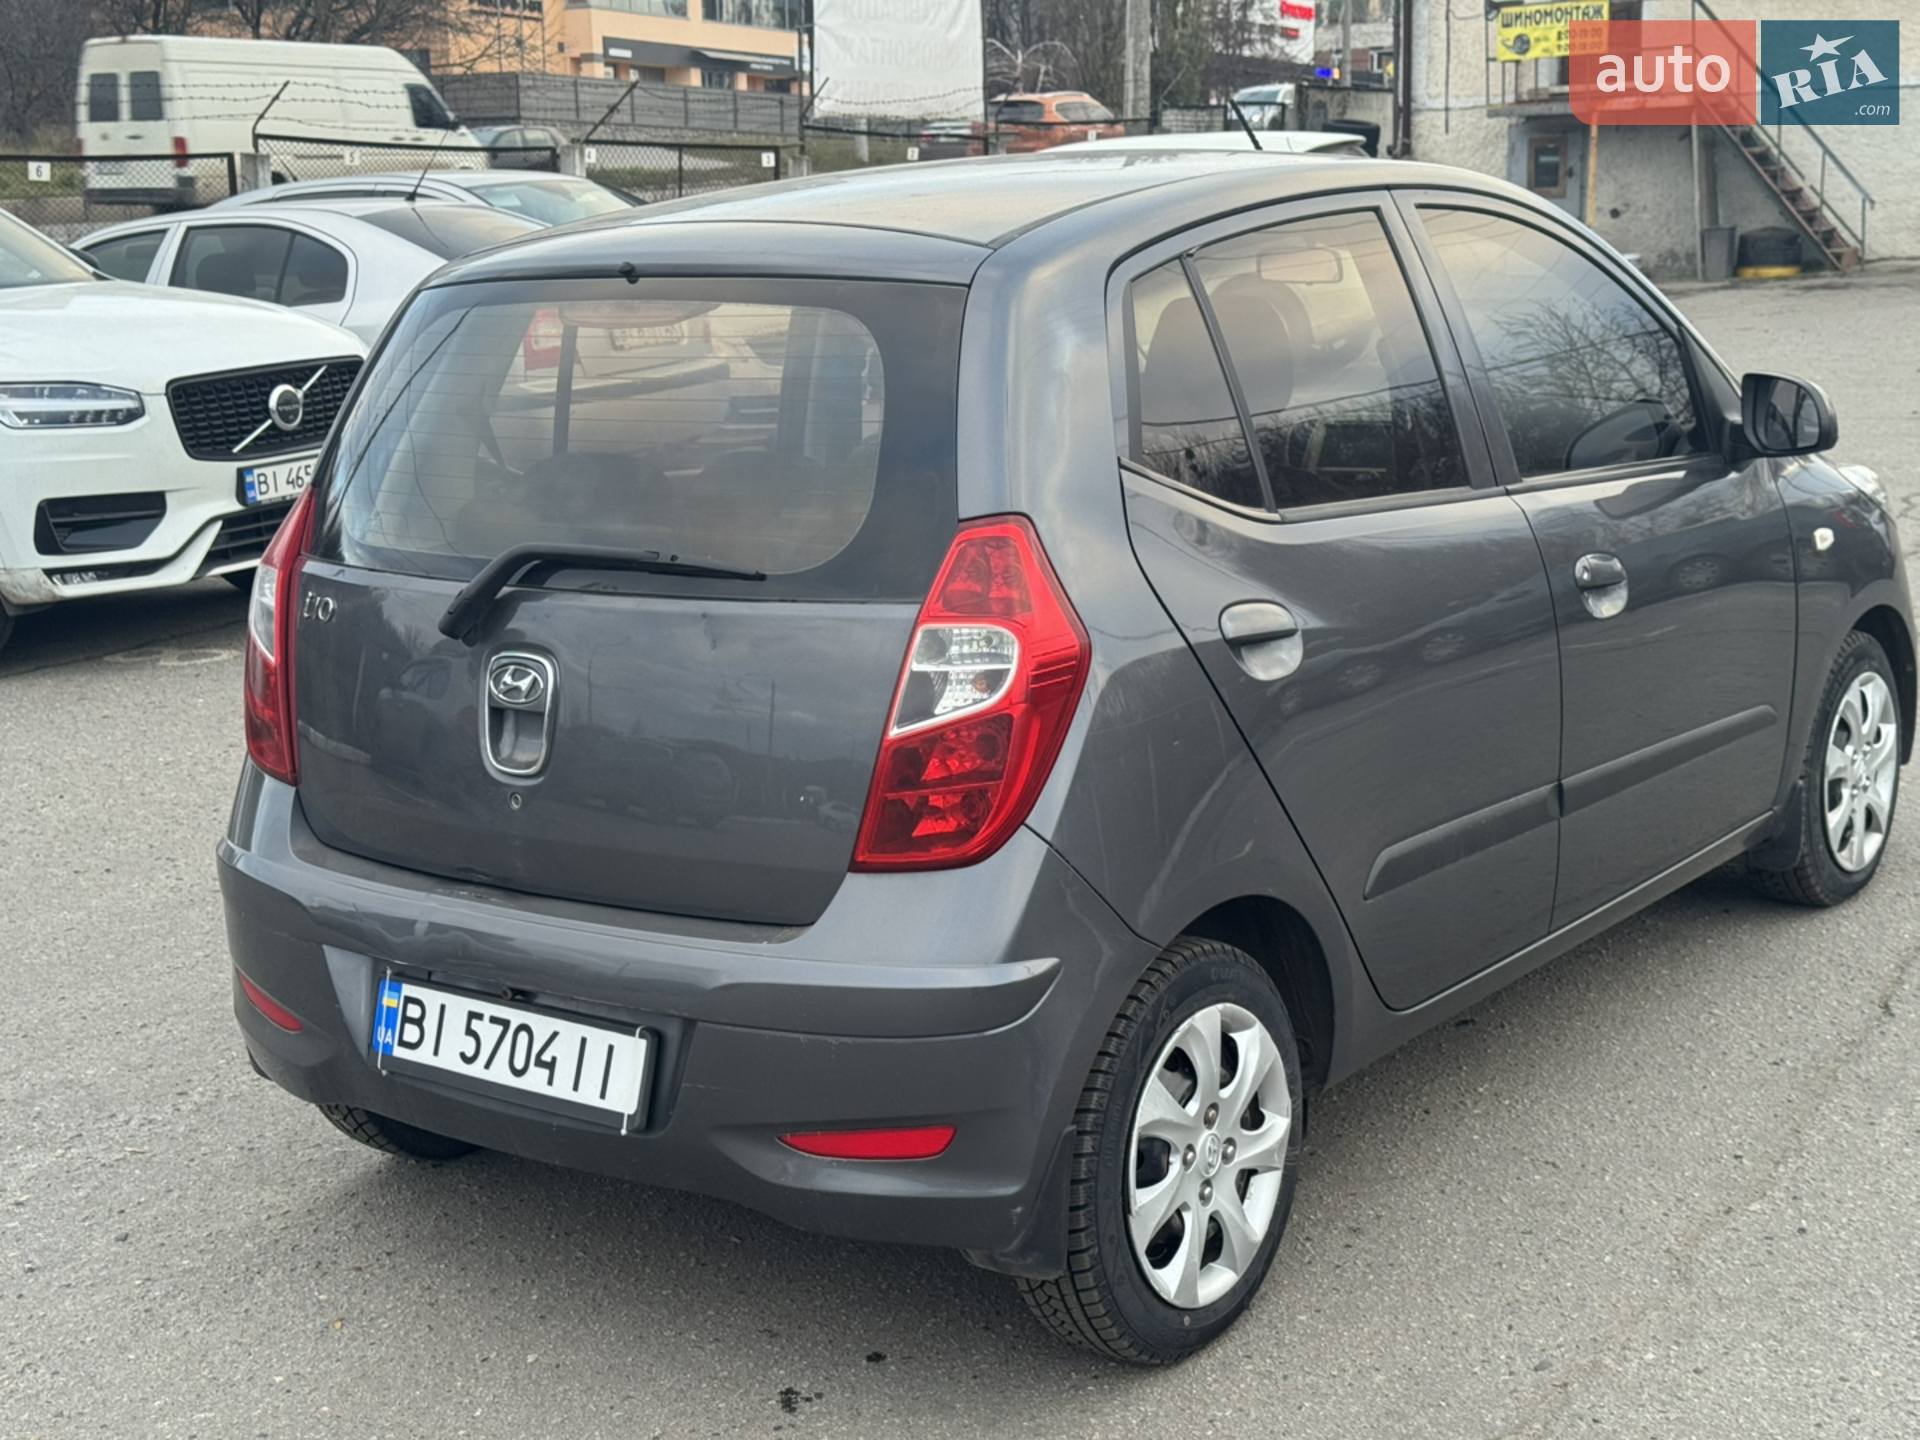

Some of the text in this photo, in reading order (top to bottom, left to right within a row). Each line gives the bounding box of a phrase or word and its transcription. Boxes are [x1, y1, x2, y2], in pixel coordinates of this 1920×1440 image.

[1501, 4, 1604, 28] ШИНОМОНТАЖ
[35, 164, 43, 178] 6
[256, 469, 278, 496] BI
[375, 1025, 393, 1046] UA
[397, 994, 446, 1058] BI
[459, 1009, 561, 1088] 5704
